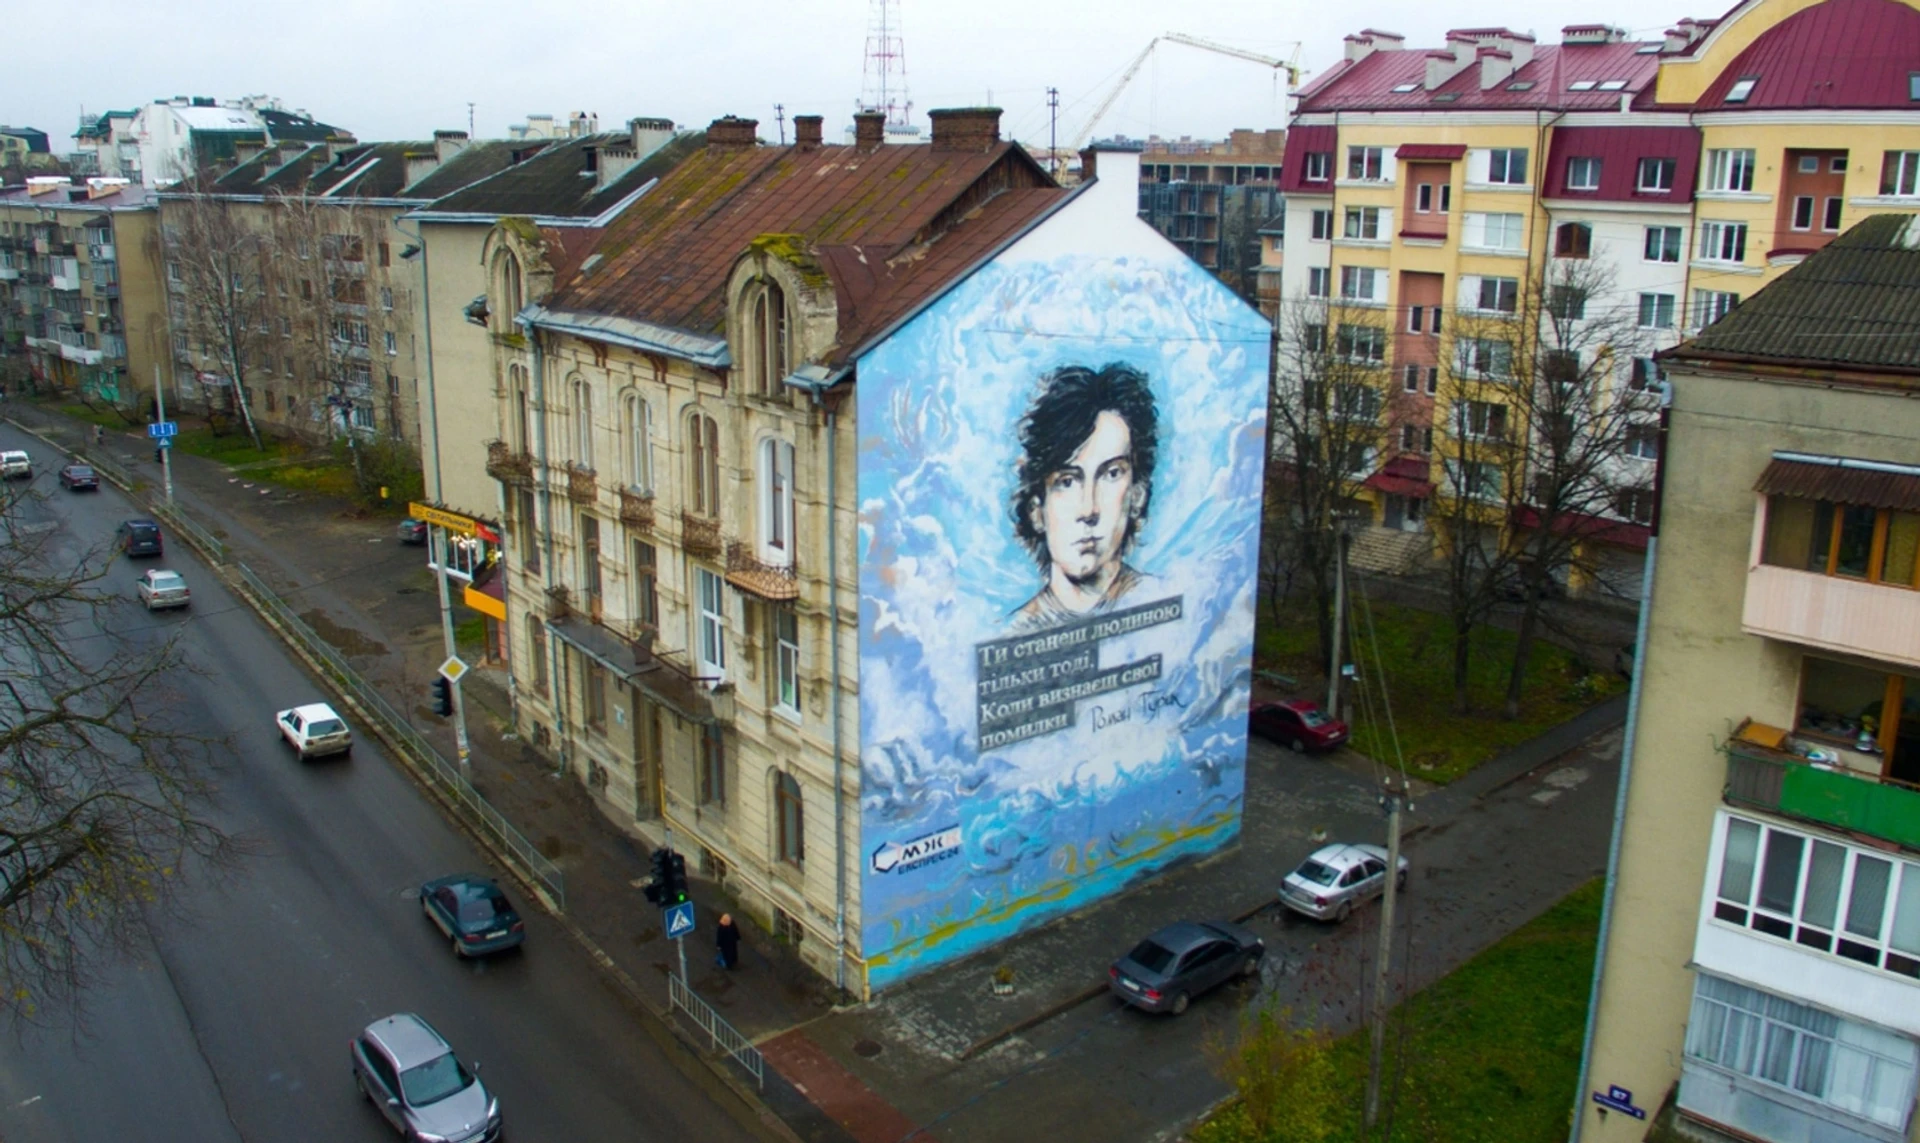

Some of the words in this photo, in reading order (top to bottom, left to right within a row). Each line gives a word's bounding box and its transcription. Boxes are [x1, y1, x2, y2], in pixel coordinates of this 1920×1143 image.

[979, 645, 1008, 667] Ти
[1013, 629, 1087, 658] станеш
[1091, 603, 1180, 639] людиною
[979, 669, 1045, 696] тільки
[980, 697, 1034, 724] Коли
[1039, 674, 1119, 706] визнаєш
[1121, 655, 1159, 682] свої
[981, 713, 1068, 749] помилки
